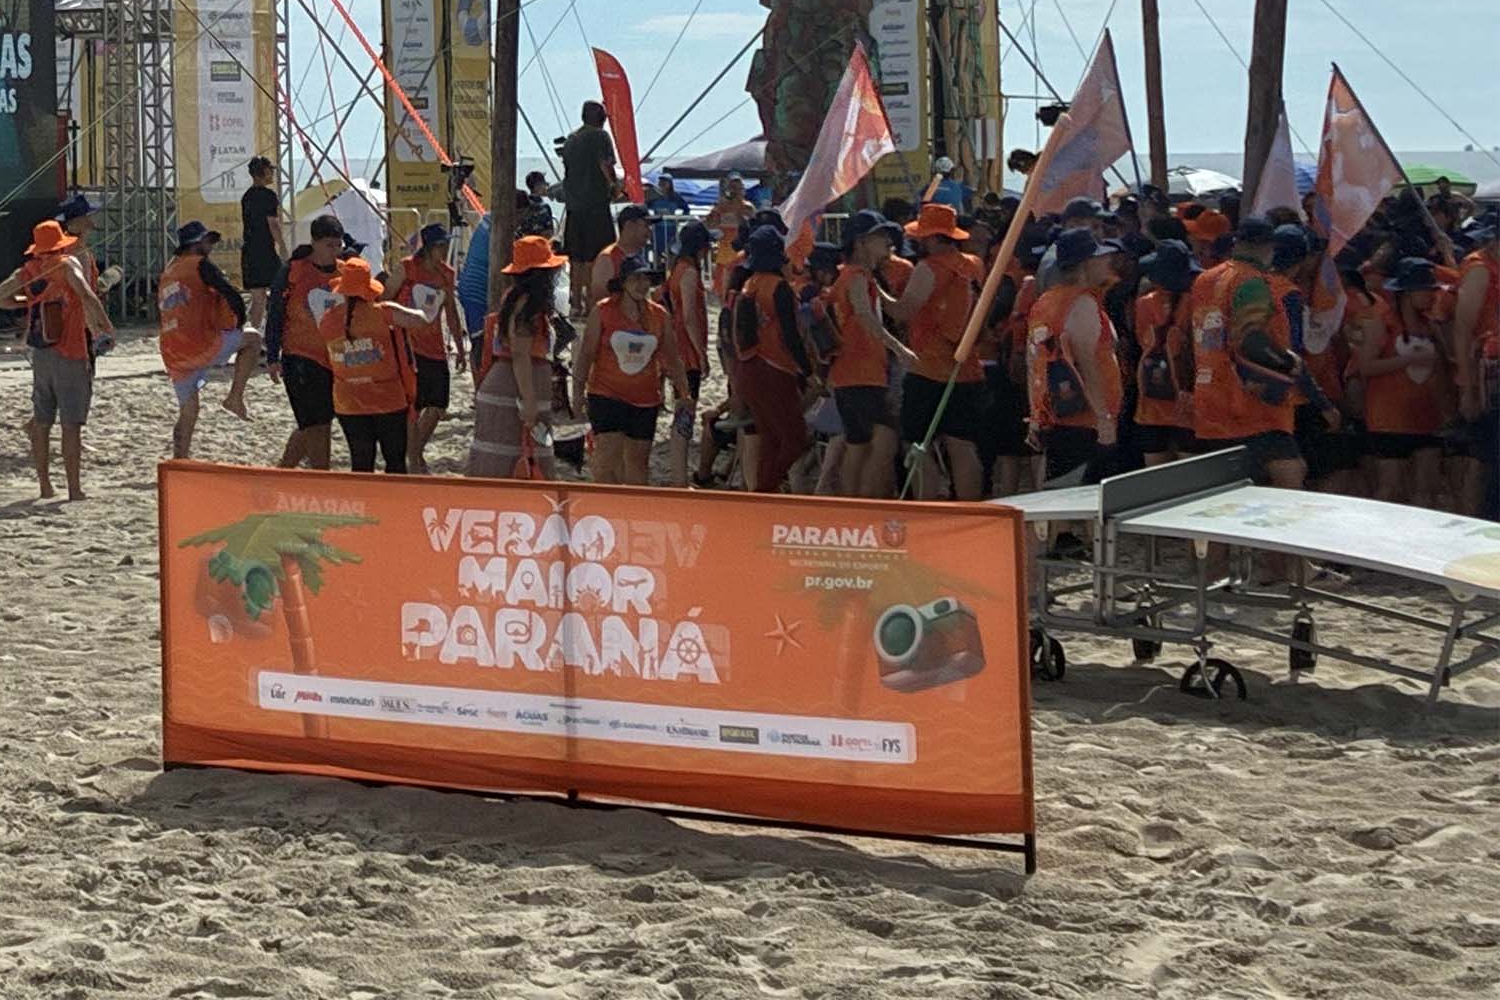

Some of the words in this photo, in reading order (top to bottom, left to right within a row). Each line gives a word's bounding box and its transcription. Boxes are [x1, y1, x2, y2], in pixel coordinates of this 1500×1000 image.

[422, 493, 616, 561] VERÃO
[771, 524, 879, 548] PARANÁ
[457, 555, 656, 616] MAIOR
[804, 575, 874, 590] pr.gov.br
[400, 607, 721, 685] PARANÁ
